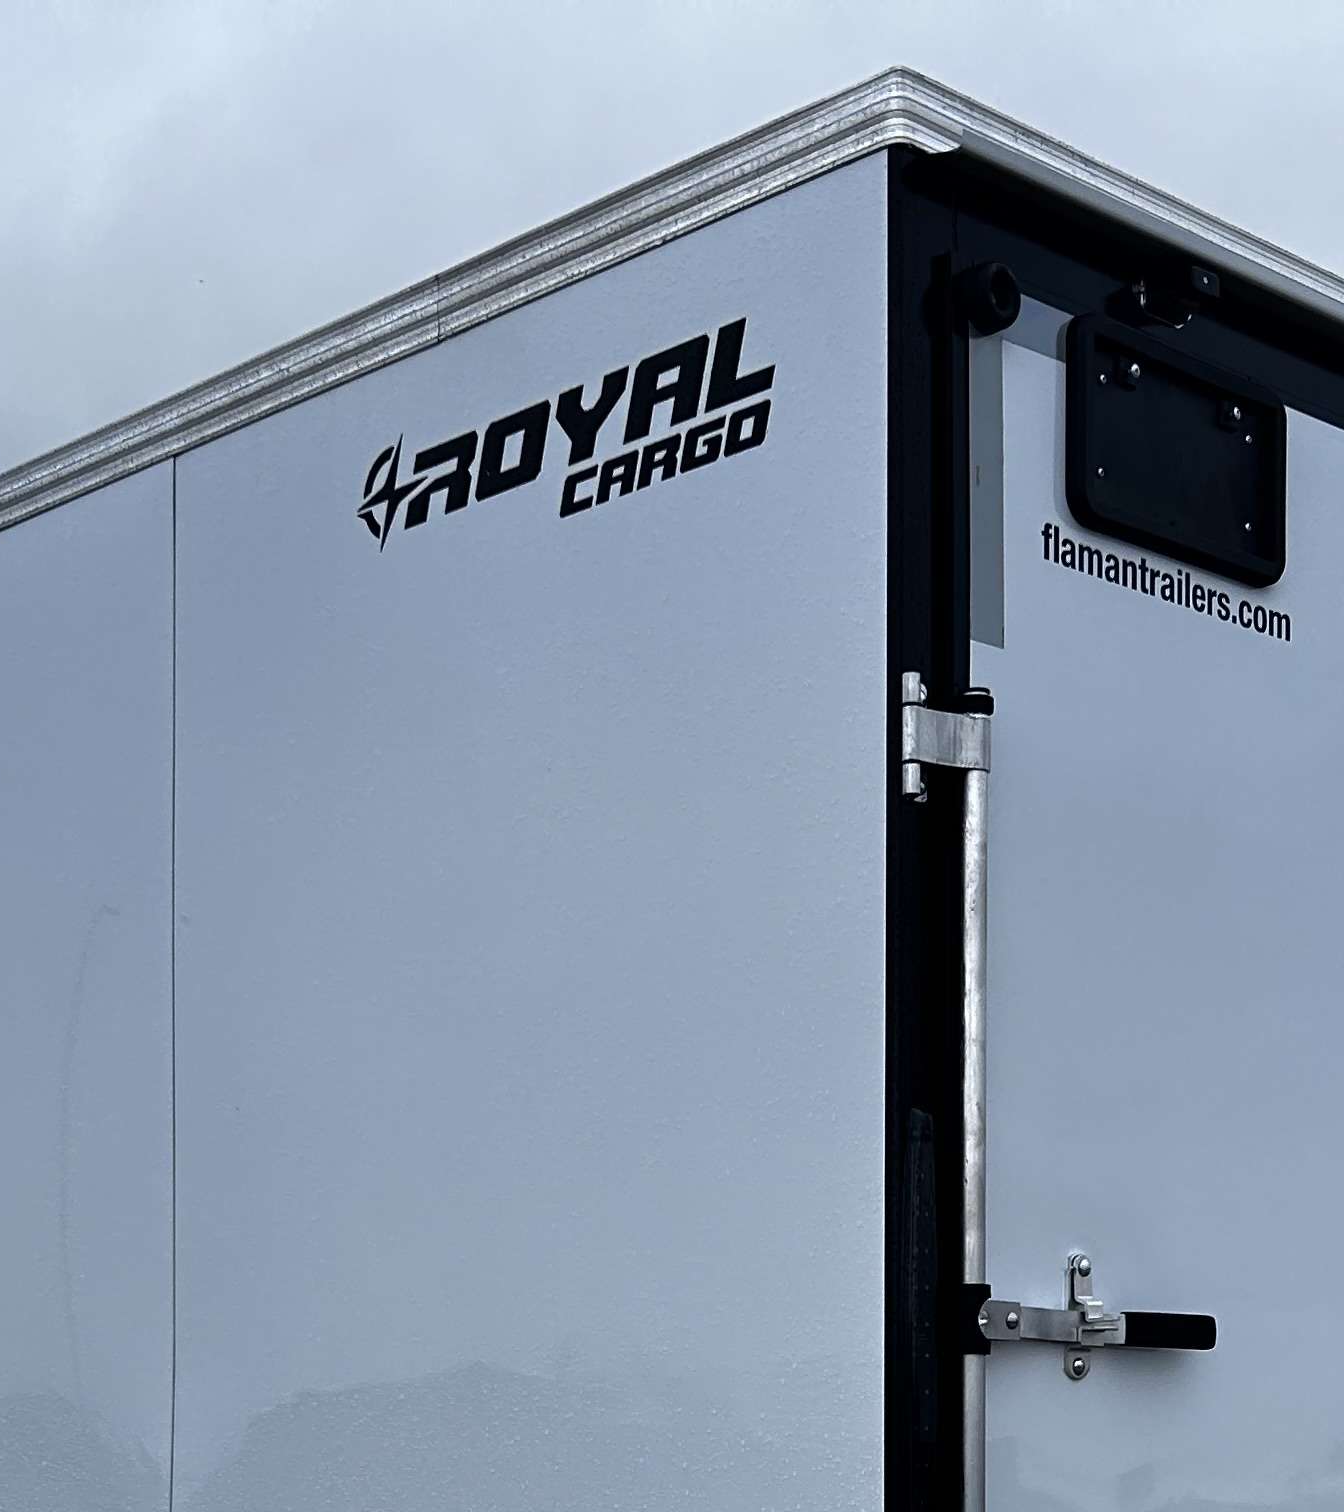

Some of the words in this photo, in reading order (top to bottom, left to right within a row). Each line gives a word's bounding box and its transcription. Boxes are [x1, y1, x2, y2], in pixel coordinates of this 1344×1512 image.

[403, 316, 777, 530] ROYAL
[559, 398, 772, 518] CARGO
[1041, 522, 1292, 642] flamantrailers.com
